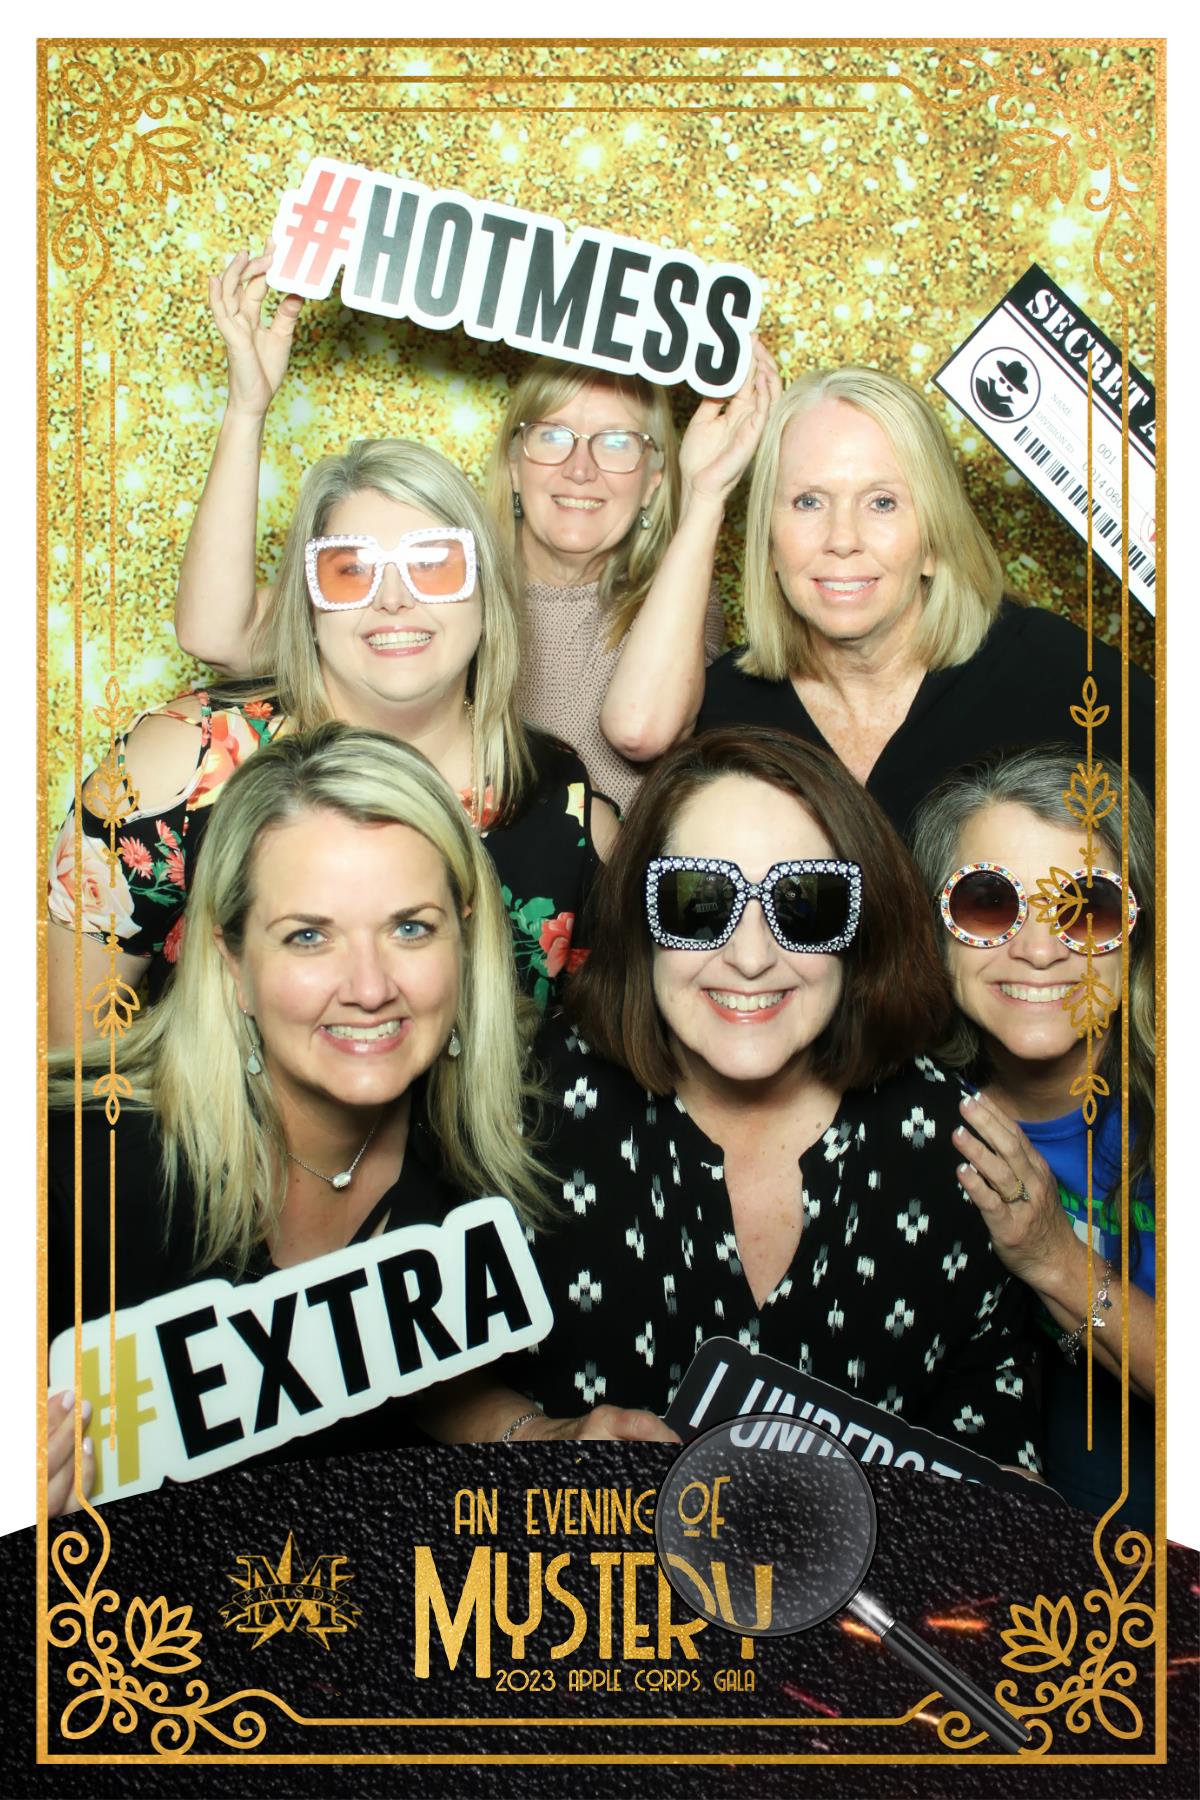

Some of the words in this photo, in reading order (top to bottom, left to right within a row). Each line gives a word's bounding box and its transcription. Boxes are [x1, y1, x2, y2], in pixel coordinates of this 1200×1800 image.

[280, 170, 751, 387] #HOTMESS
[1025, 288, 1150, 415] SECRET
[81, 1221, 533, 1497] #EXTRA
[688, 1361, 729, 1429] I
